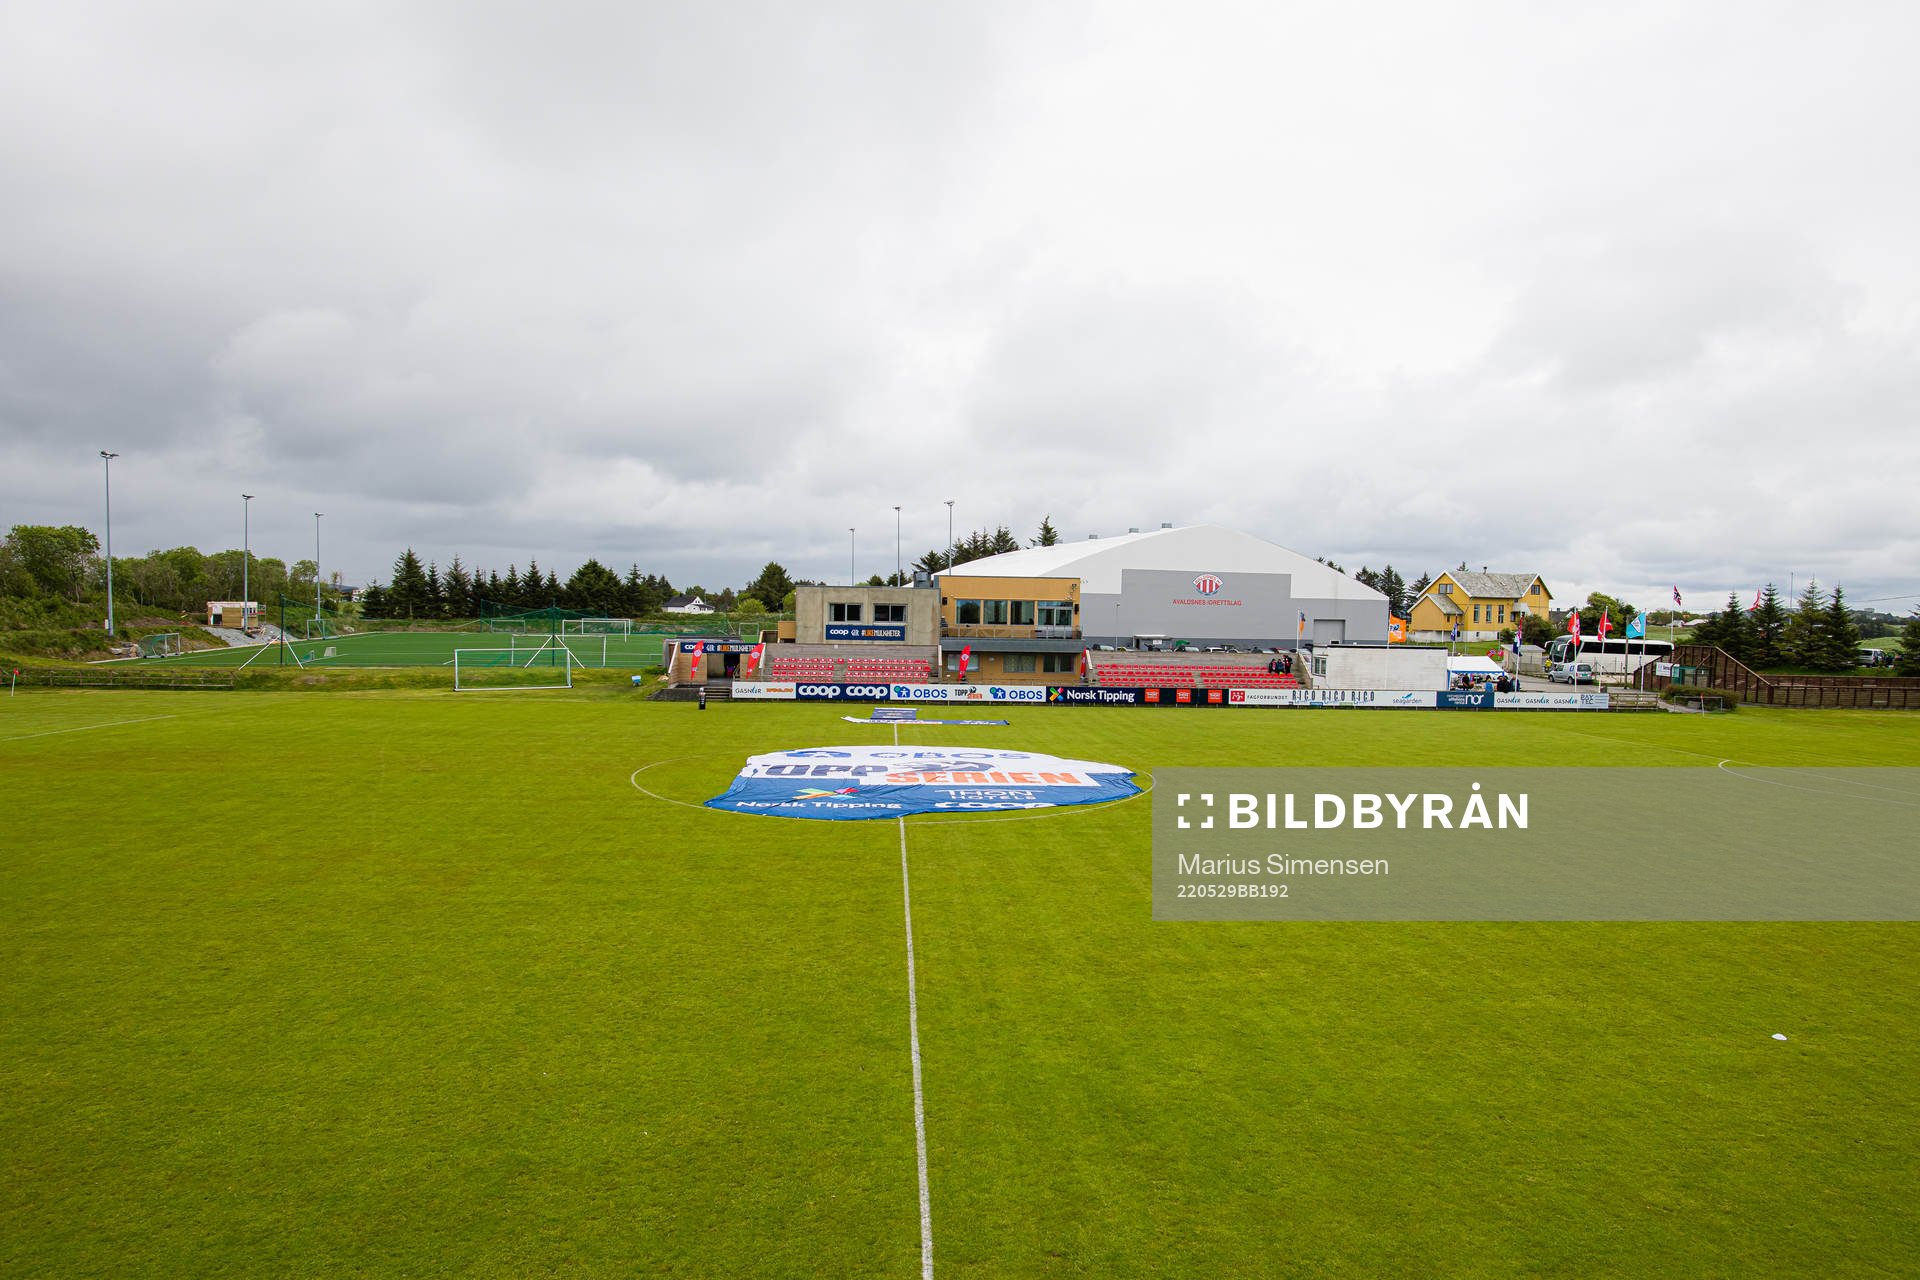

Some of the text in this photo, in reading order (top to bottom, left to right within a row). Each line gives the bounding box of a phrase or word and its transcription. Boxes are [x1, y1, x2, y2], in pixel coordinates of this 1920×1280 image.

[829, 628, 849, 636] coop
[798, 685, 841, 698] coop
[846, 686, 888, 699] coop
[913, 688, 948, 698] OBOS
[1009, 689, 1043, 699] OBOS
[1066, 690, 1096, 700] Norsk
[1097, 690, 1135, 702] Tipping
[1465, 694, 1484, 705] nor
[869, 751, 1031, 759] OBOS
[762, 764, 889, 777] OPP
[885, 771, 1081, 784] SERIEN
[812, 801, 902, 809] Tipping
